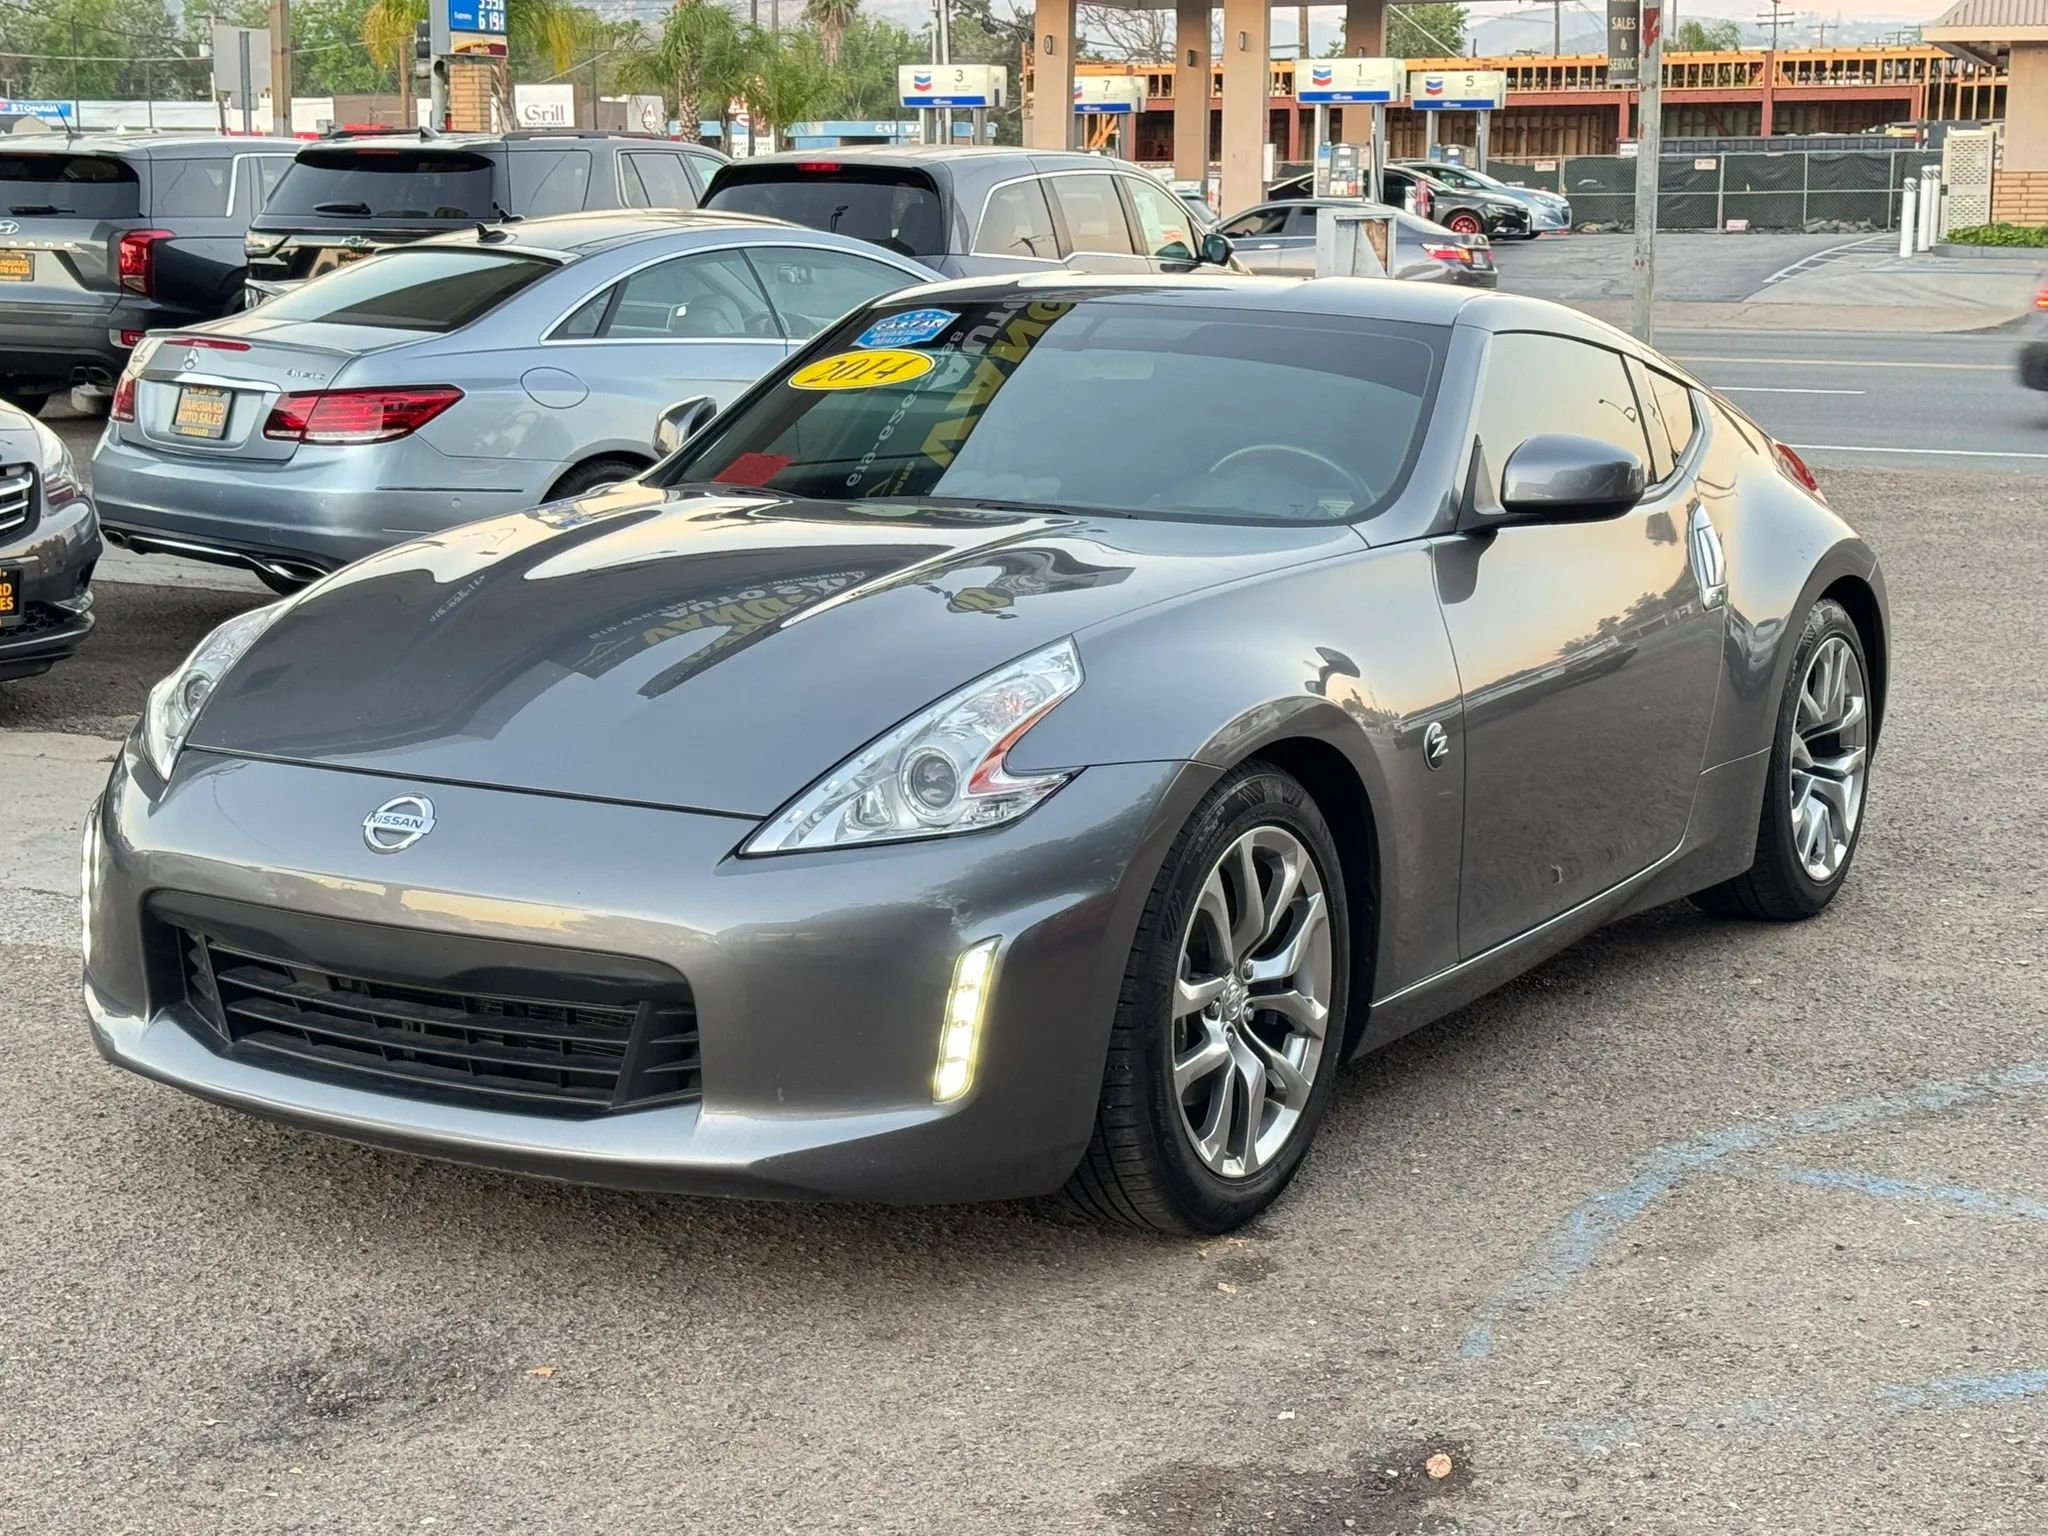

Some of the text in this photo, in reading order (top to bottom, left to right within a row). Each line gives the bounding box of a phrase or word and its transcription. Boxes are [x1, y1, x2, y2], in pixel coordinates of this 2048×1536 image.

[1612, 17, 1637, 30] SALES
[1621, 37, 1628, 51] &
[1357, 63, 1362, 77] 1
[1609, 57, 1638, 71] SERVIC
[955, 69, 964, 82] 3
[1465, 75, 1475, 87] 5
[1104, 79, 1111, 91] 7
[524, 104, 564, 121] Grill
[803, 357, 921, 385] 2014
[183, 400, 224, 414] VANGUARD
[180, 410, 223, 425] AUTO SALES
[1431, 735, 1449, 758] Z
[367, 814, 424, 829] NISSAN
